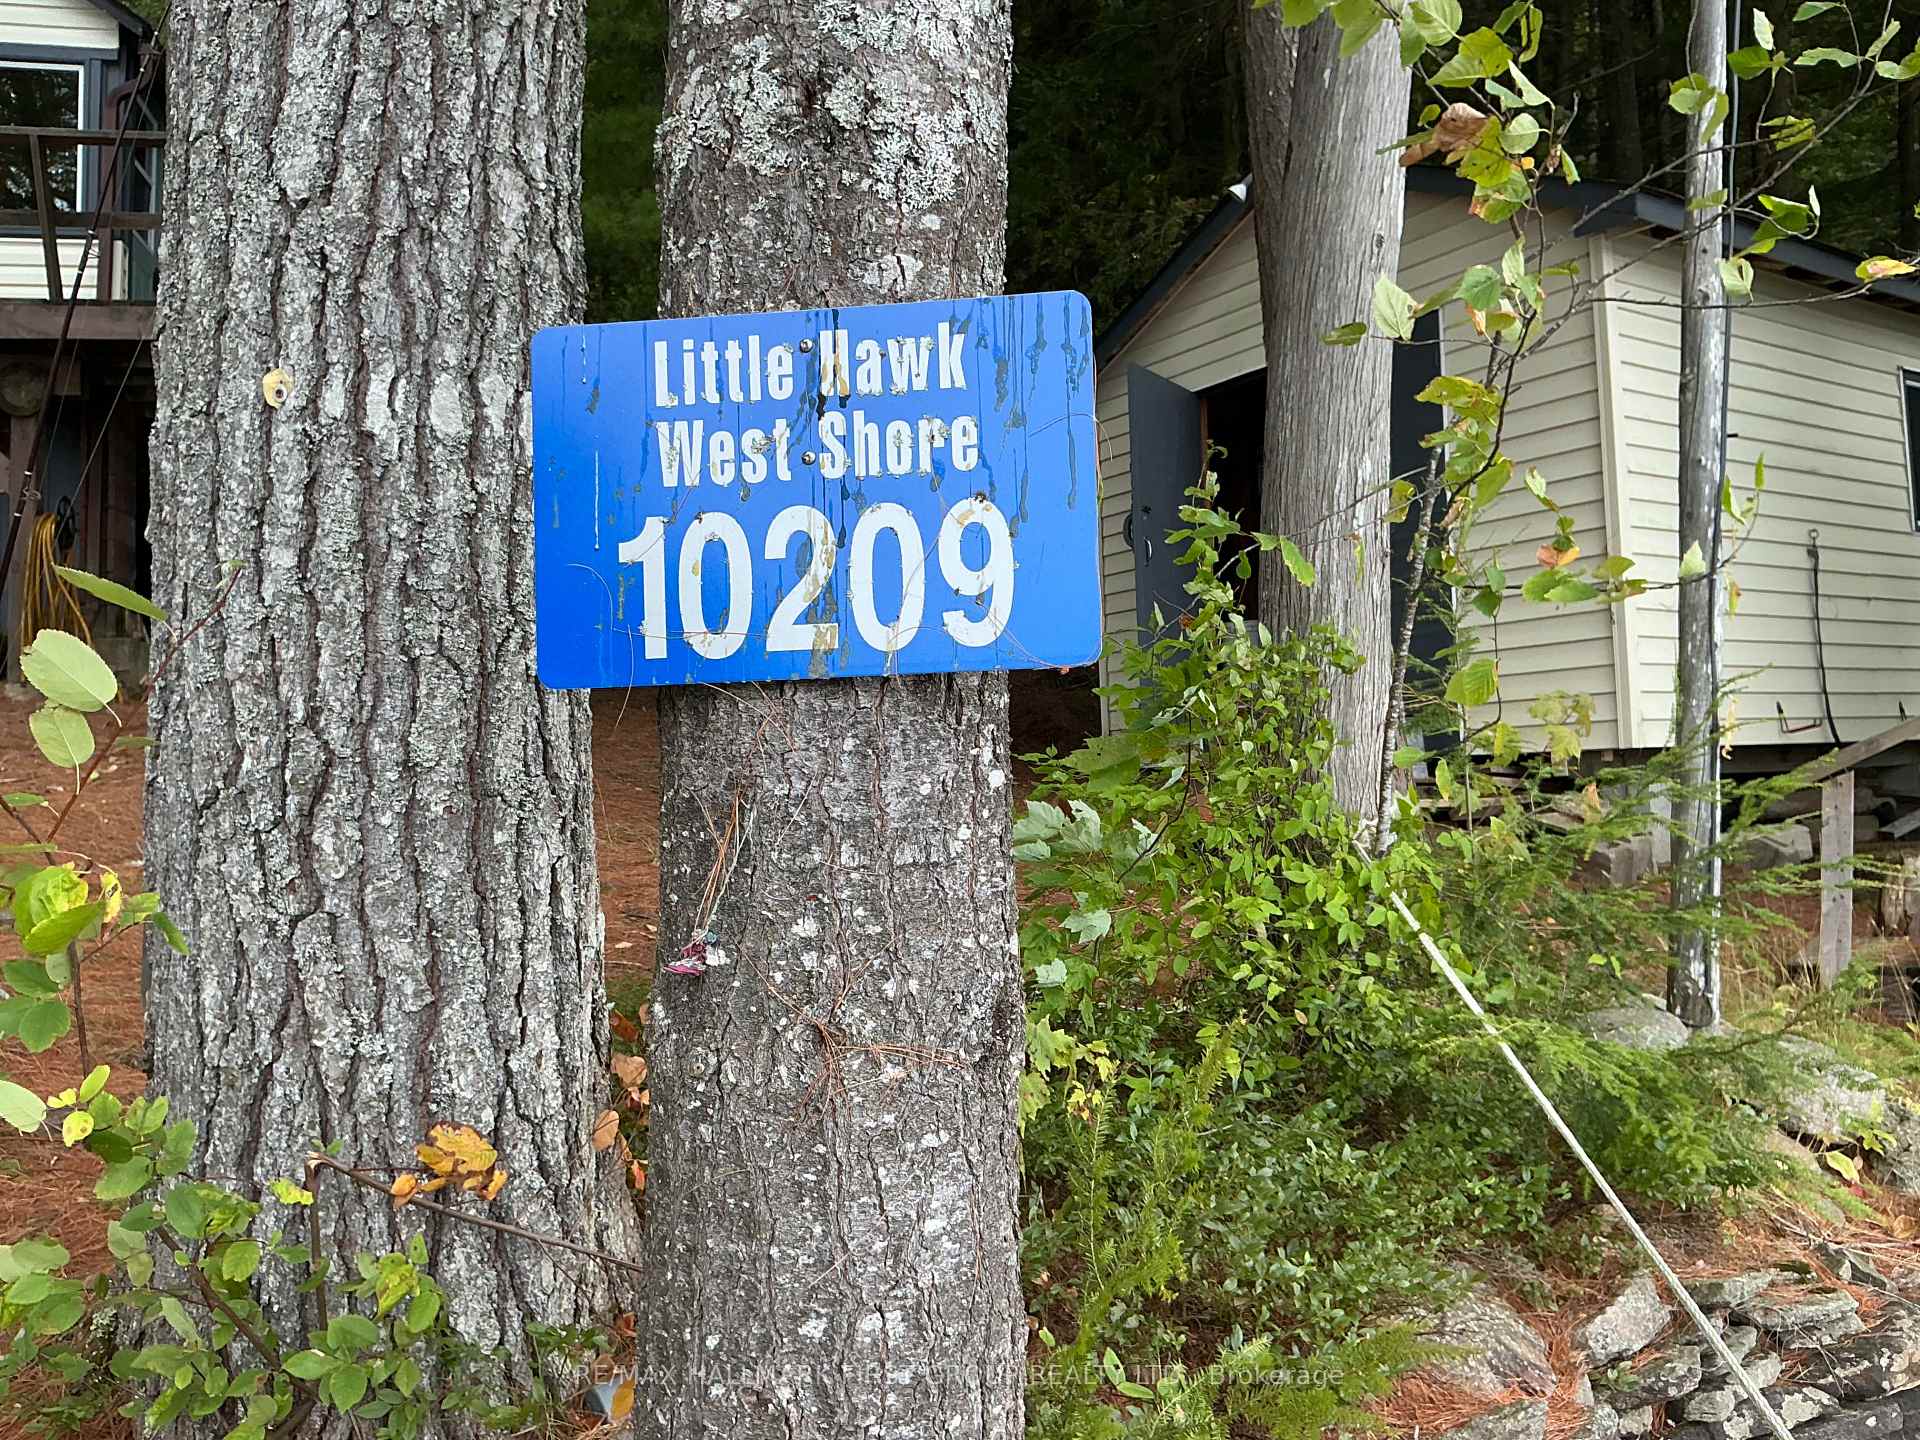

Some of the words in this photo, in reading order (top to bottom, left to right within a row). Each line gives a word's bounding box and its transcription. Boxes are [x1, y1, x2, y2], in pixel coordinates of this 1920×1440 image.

[653, 334, 795, 407] Little
[817, 321, 967, 398] Hawk
[656, 418, 792, 488] West
[818, 409, 979, 480] Shore
[618, 497, 1016, 660] 10209
